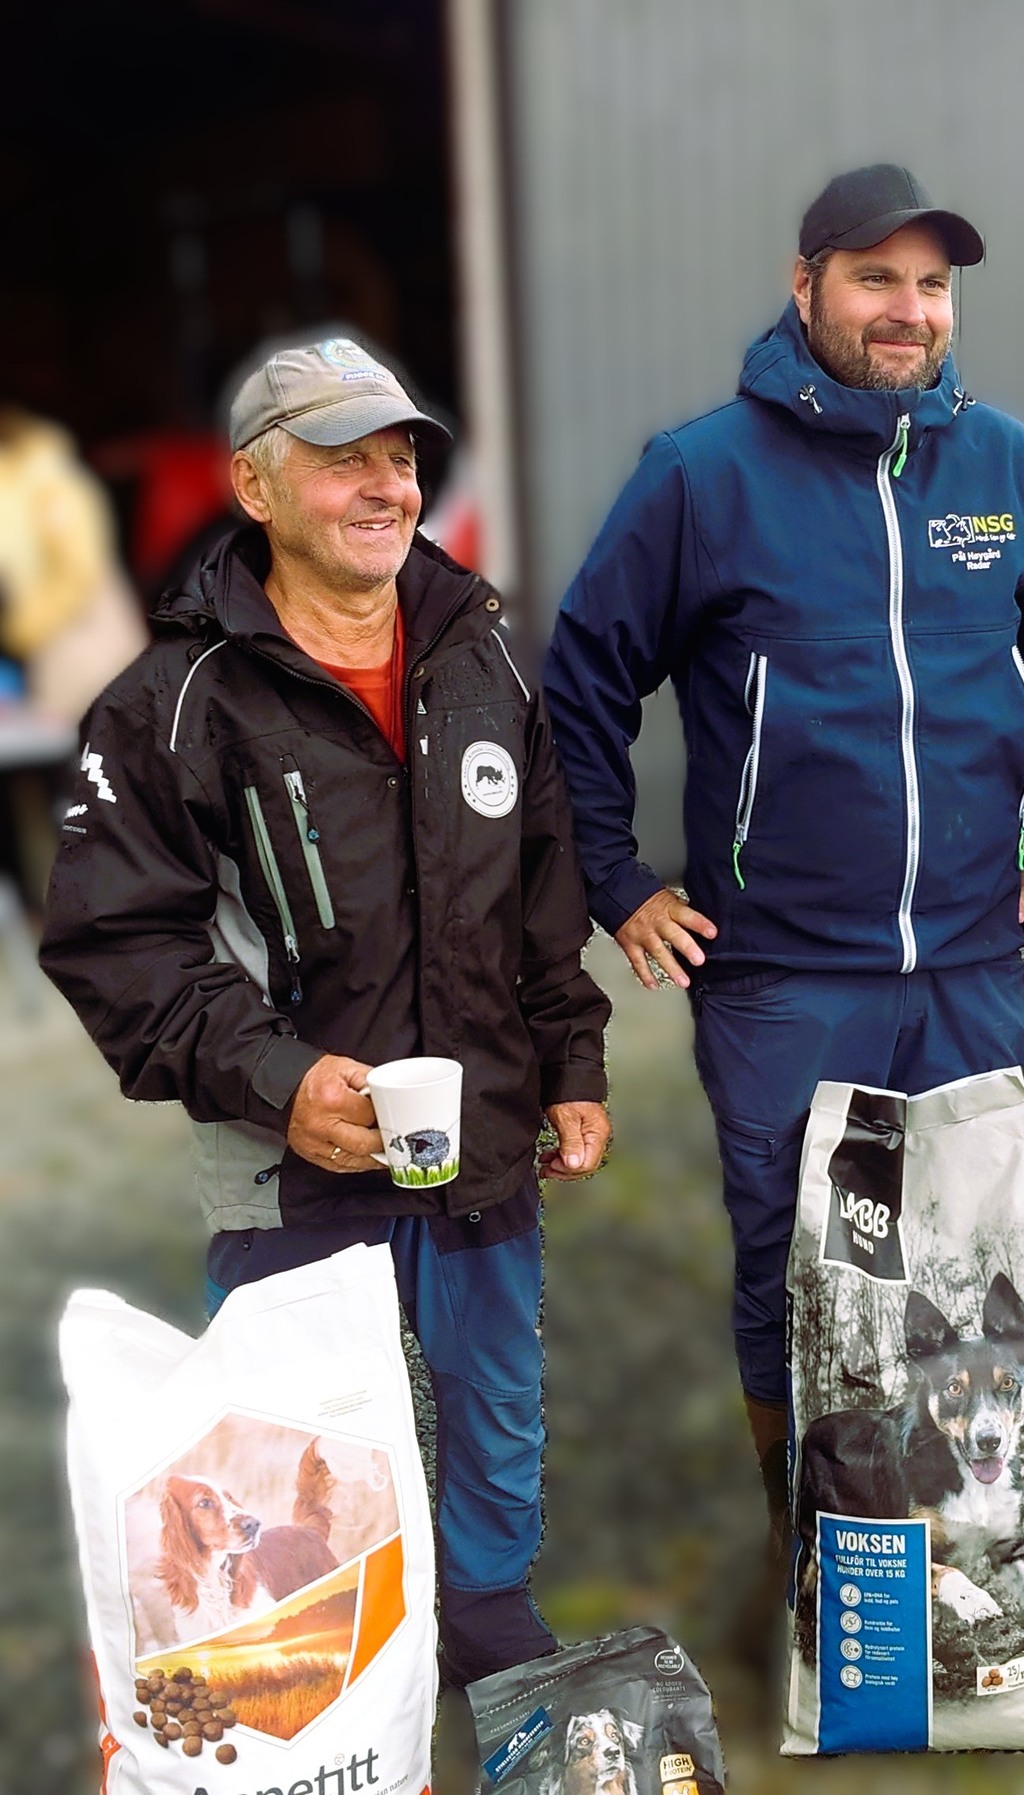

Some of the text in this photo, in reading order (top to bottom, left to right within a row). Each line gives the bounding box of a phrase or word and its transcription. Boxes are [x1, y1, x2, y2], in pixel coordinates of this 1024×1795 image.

[973, 514, 1013, 533] NSG
[836, 1530, 906, 1554] VOKSEN
[866, 1558, 876, 1567] TIL
[878, 1559, 907, 1568] VOKSNE
[837, 1565, 906, 1579] HUNDER OVER 15 KG
[663, 1757, 690, 1770] HIGH
